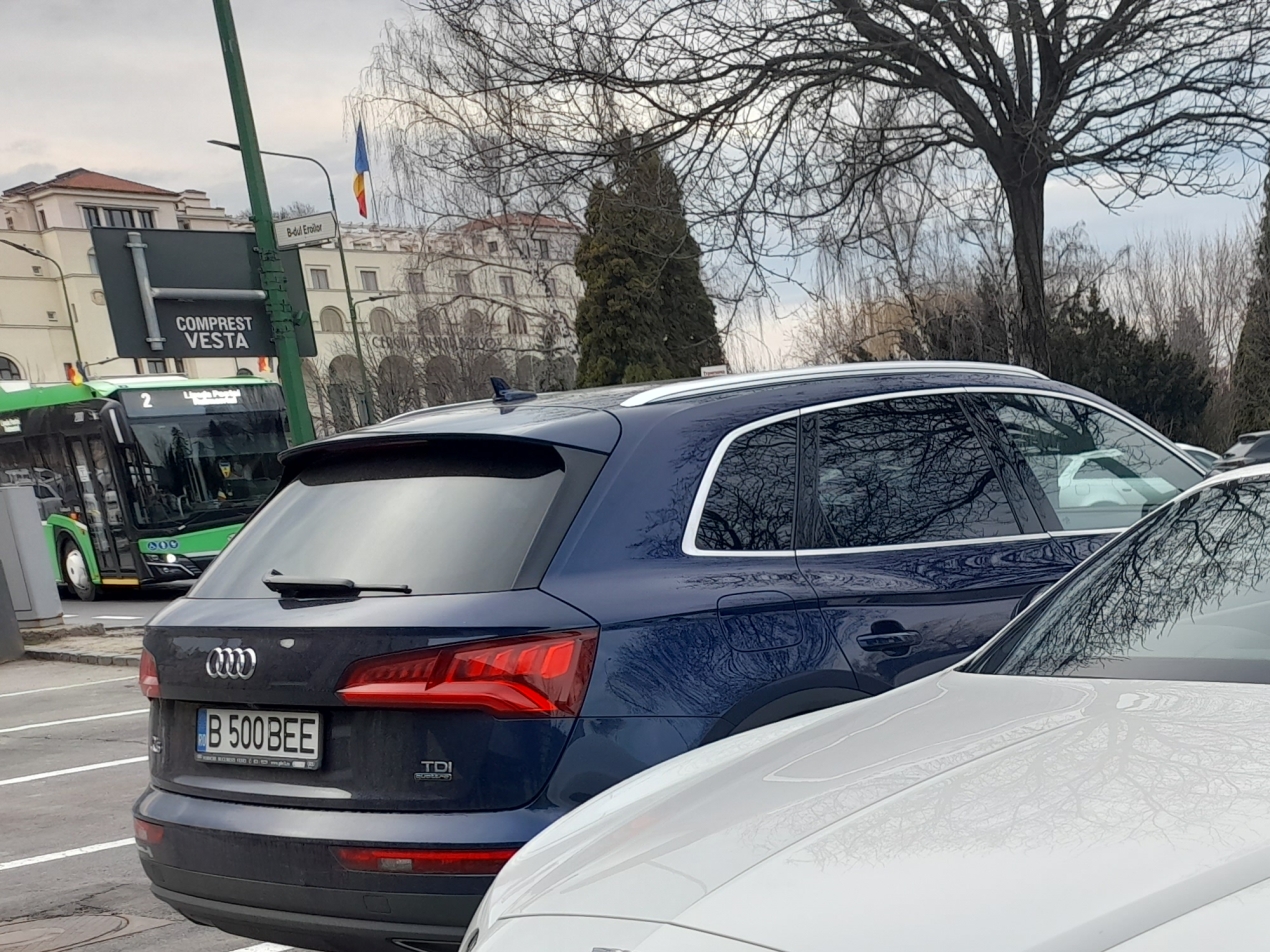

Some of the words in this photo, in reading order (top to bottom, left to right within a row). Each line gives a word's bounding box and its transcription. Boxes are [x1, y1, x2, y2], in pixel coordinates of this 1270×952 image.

[286, 225, 302, 237] B-dul
[176, 316, 253, 331] COMPREST
[184, 332, 250, 349] VESTA
[141, 393, 153, 408] 2
[208, 714, 222, 748] B
[421, 761, 452, 772] TDI
